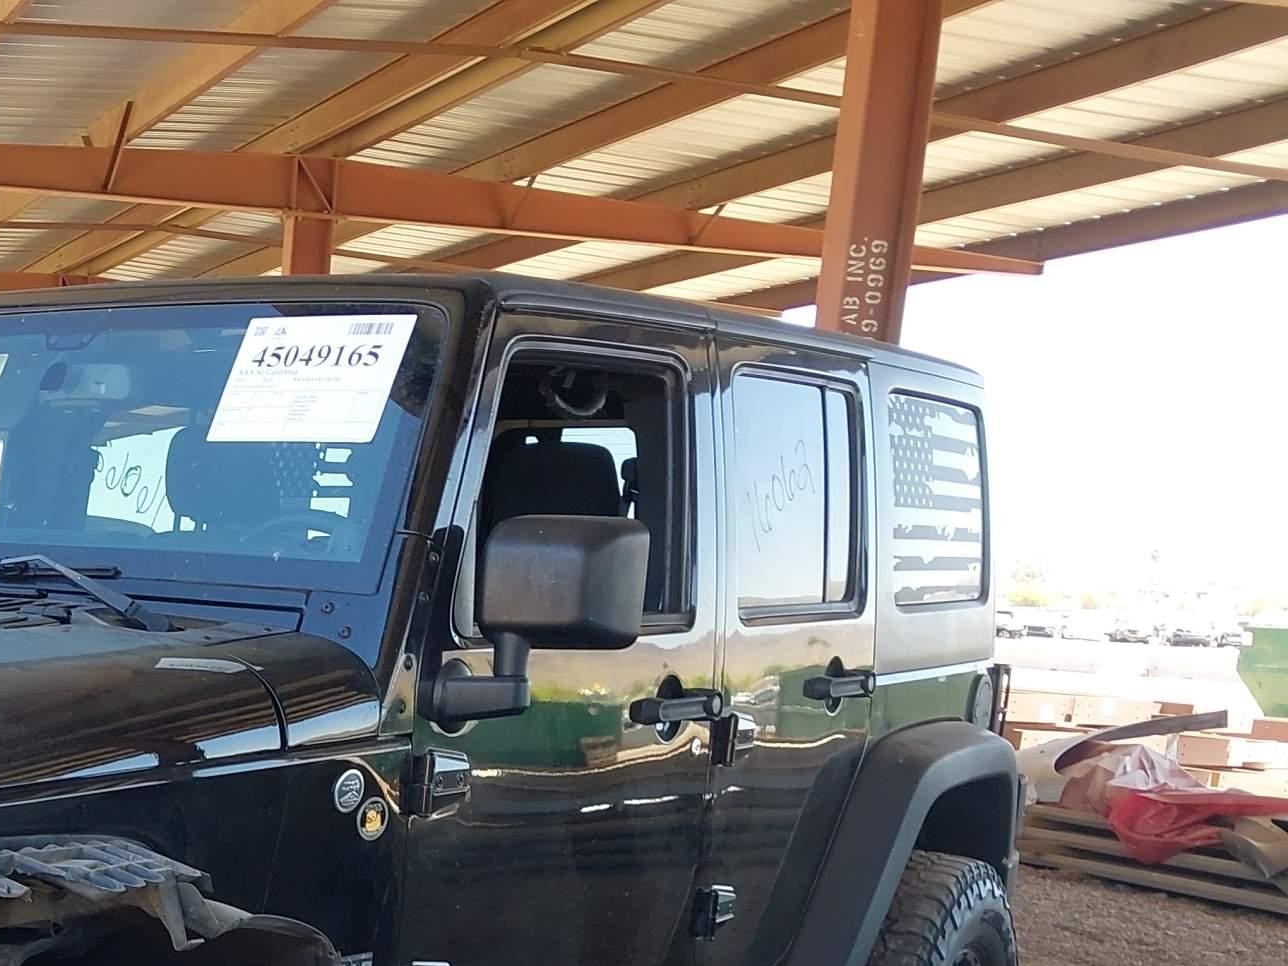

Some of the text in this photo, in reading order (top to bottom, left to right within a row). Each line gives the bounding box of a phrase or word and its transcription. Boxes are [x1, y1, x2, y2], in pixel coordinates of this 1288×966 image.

[841, 237, 867, 336] AB INC.
[861, 239, 888, 338] 9-0969
[252, 344, 383, 367] 45049165
